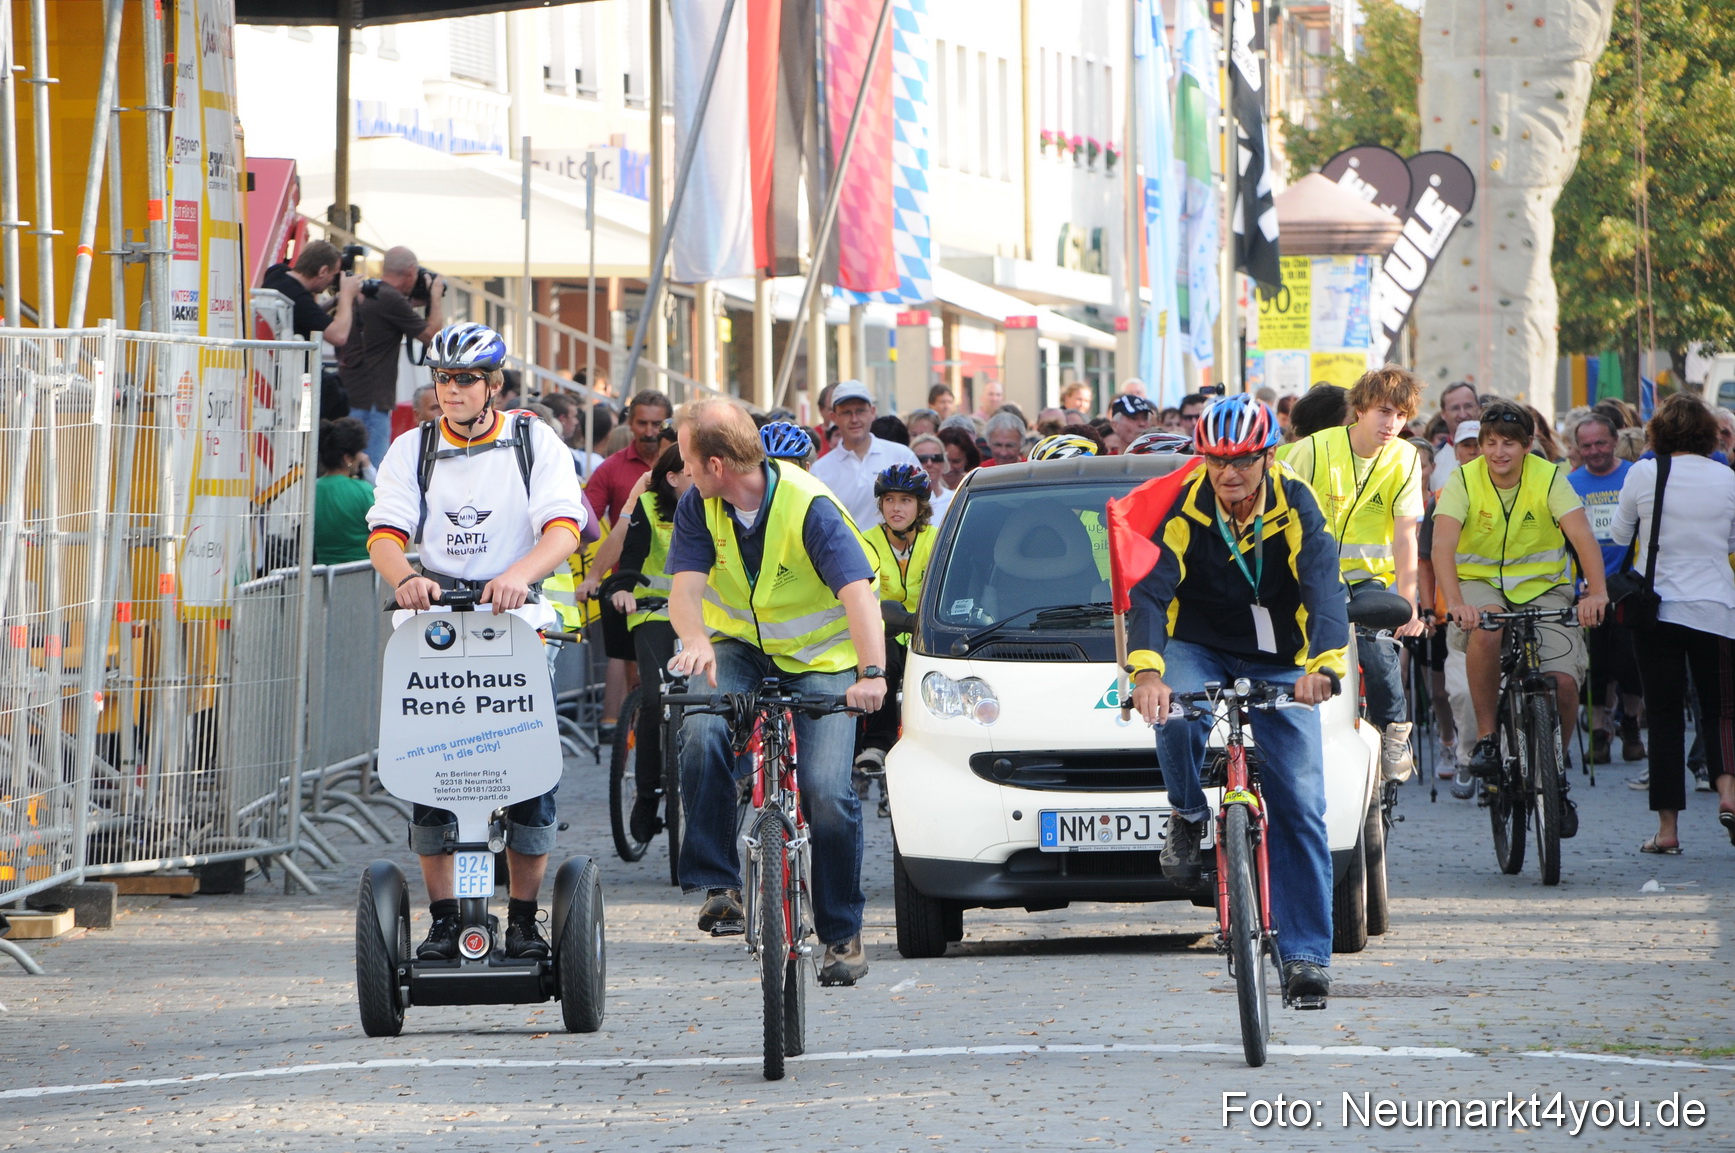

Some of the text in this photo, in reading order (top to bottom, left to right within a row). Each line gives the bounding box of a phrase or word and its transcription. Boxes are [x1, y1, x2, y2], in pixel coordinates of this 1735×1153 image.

[1379, 186, 1462, 357] HULE
[1595, 517, 1612, 528] 80
[446, 532, 489, 546] PARTL
[407, 670, 527, 690] Autohaus
[402, 694, 534, 716] René Partl
[427, 743, 447, 754] uns
[449, 719, 544, 749] umweltfreundlich
[443, 740, 501, 762] in die City!
[440, 778, 463, 786] 92318
[482, 769, 500, 777] Ring
[436, 793, 508, 802] www.bmw-partl.de
[462, 785, 511, 793] 09181/32033
[1046, 833, 1053, 841] D
[1060, 815, 1095, 842] NM
[458, 855, 489, 874] 924
[459, 875, 489, 894] EFF
